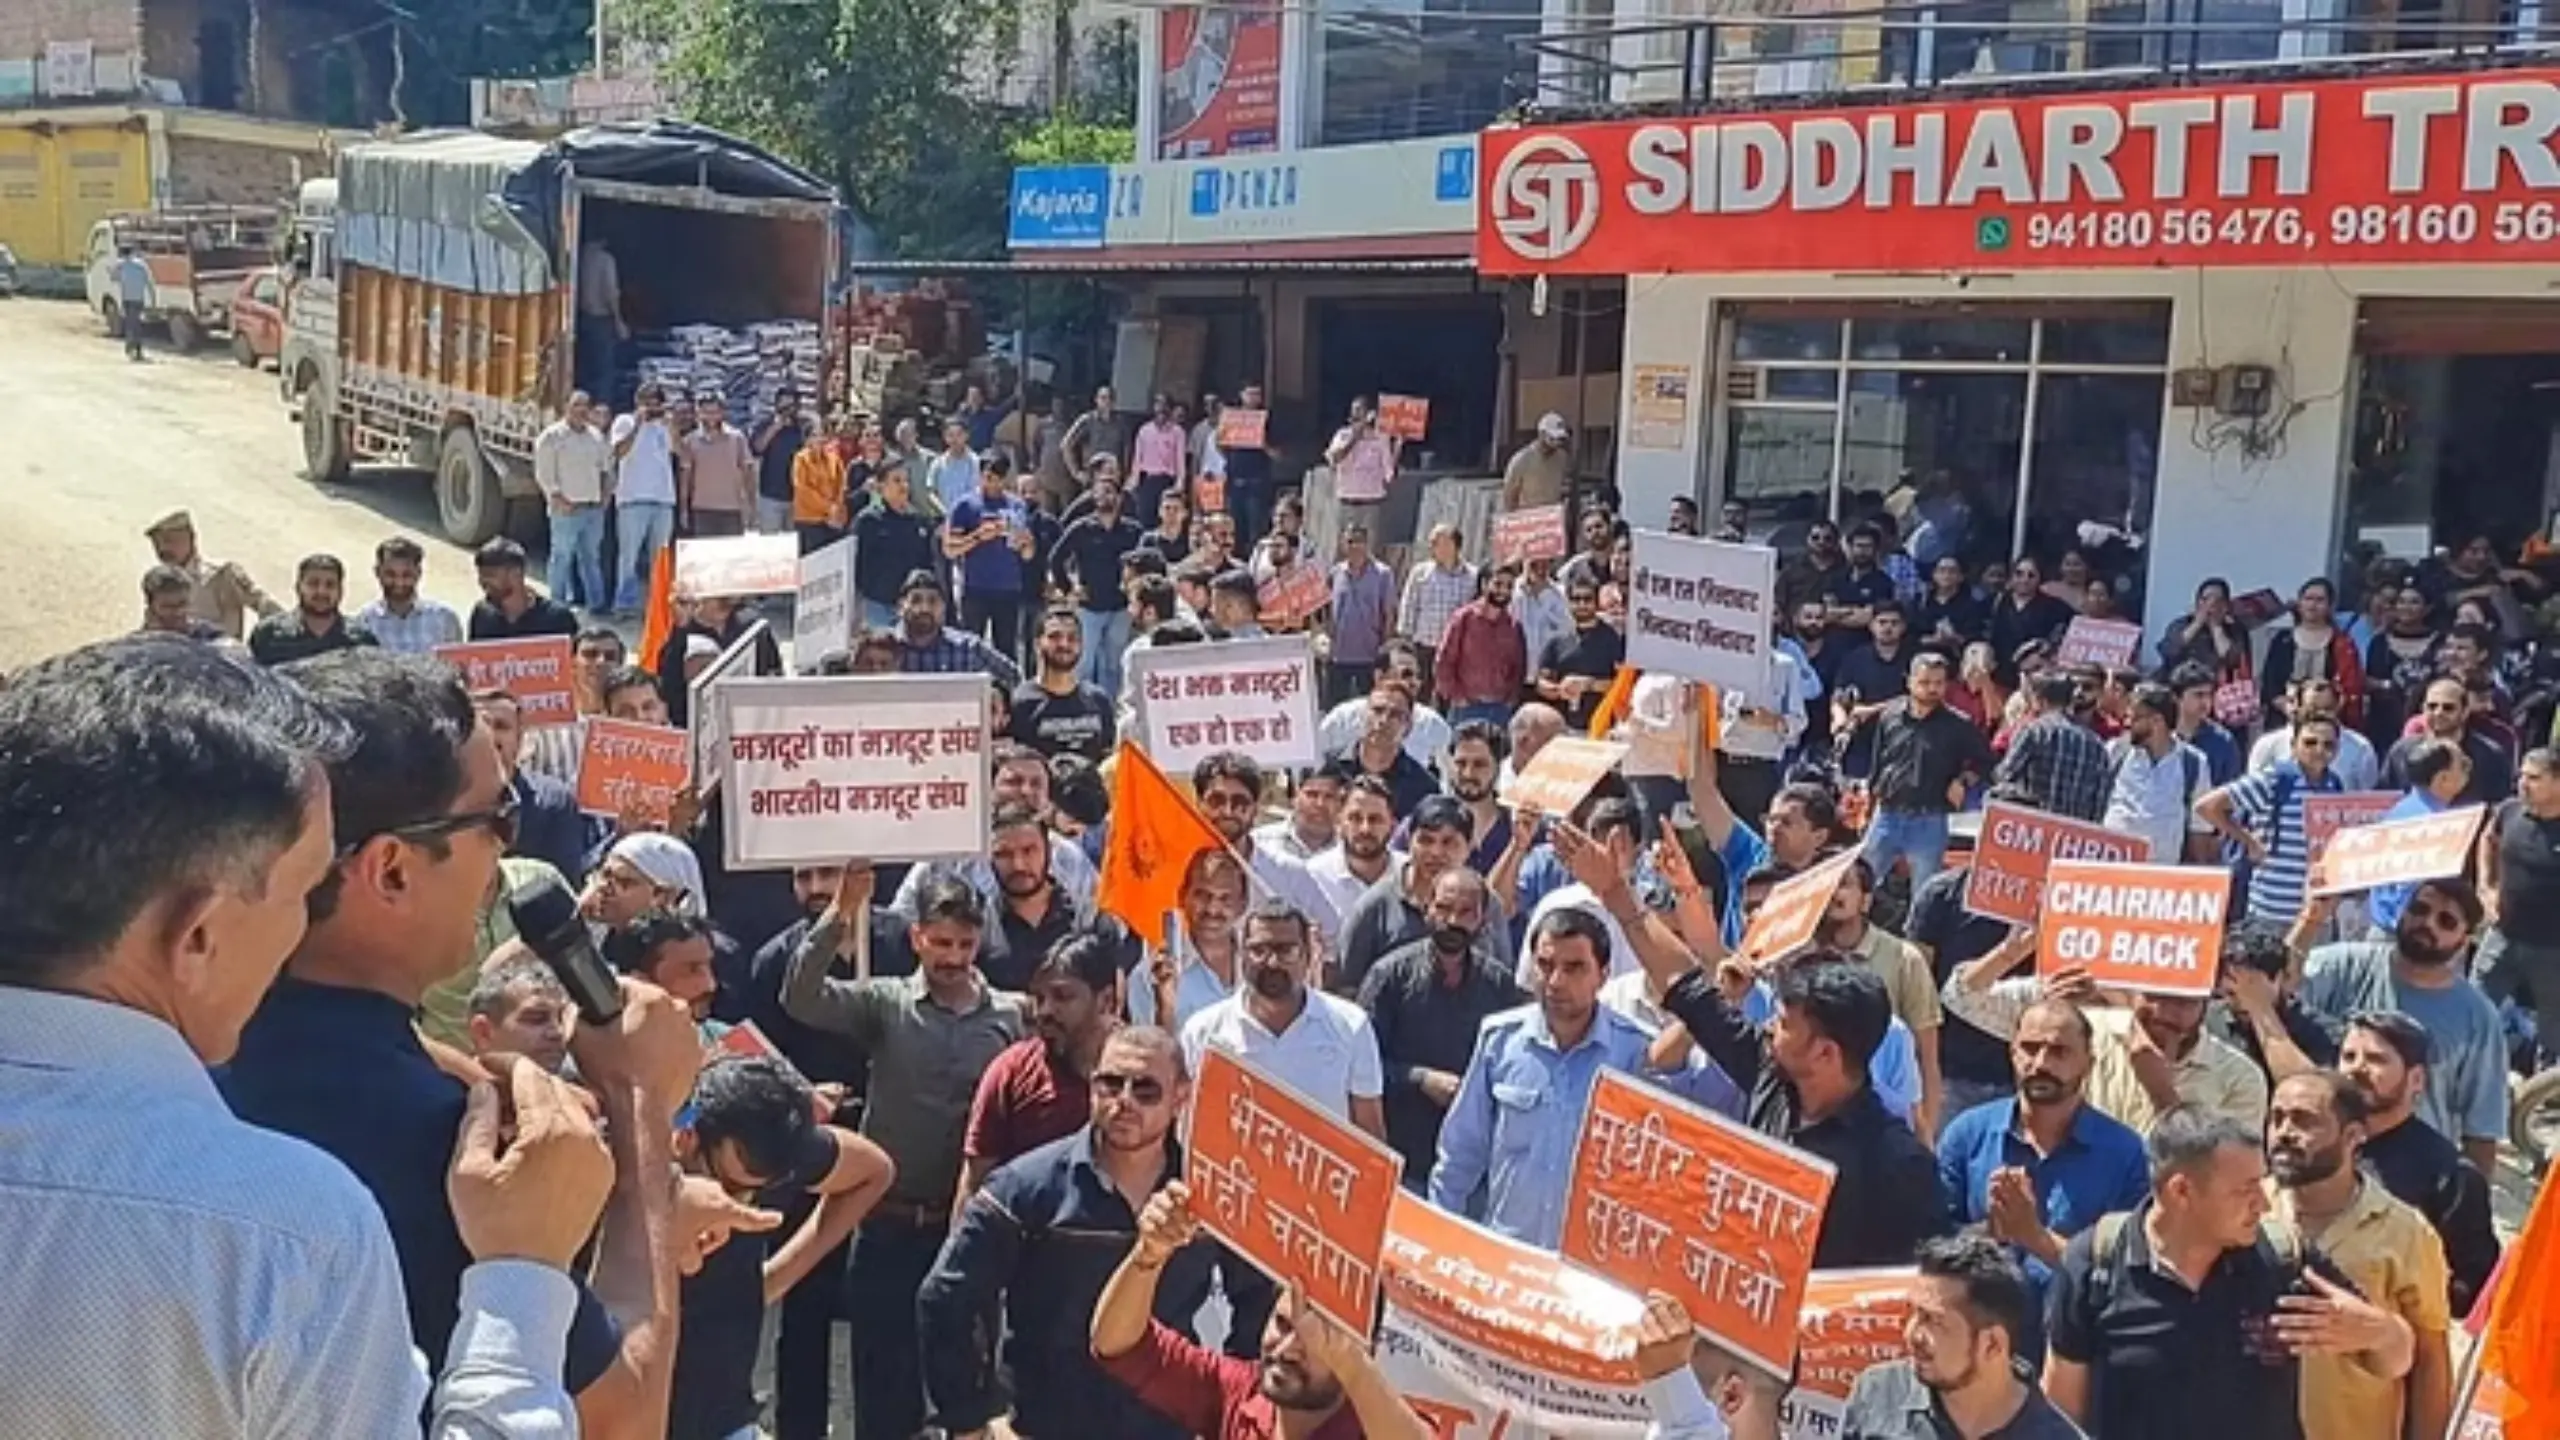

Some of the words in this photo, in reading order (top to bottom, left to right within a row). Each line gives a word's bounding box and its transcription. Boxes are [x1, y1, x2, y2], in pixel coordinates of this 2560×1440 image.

[1625, 91, 2315, 213] SIDDHARTH
[1017, 186, 1098, 221] Kajaria
[2331, 203, 2478, 244] 98160
[1146, 672, 1179, 701] देश
[1229, 663, 1303, 701] मजदूरों
[729, 725, 817, 771] मजदूरों
[820, 731, 854, 761] का
[857, 728, 935, 767] मजदूर
[938, 721, 981, 755] संघ
[1167, 721, 1202, 748] एक
[1206, 713, 1229, 745] हो
[1231, 718, 1266, 744] एक
[1269, 710, 1293, 742] हो
[749, 779, 840, 818] भारतीय
[845, 784, 923, 822] मजदूर
[926, 775, 969, 810] संघ
[1993, 819, 2045, 854] GM
[2051, 880, 2222, 926] CHAIRMAN
[2056, 925, 2102, 959] GO
[2110, 929, 2201, 971] BACK
[1229, 1073, 1361, 1214] भेदभाव
[1591, 1107, 1695, 1198] सुधीर
[1702, 1156, 1818, 1251] कुमार
[1264, 1200, 1372, 1312] चलेगा
[1586, 1187, 1674, 1270] सुधर
[1682, 1235, 1786, 1326] जाओ
